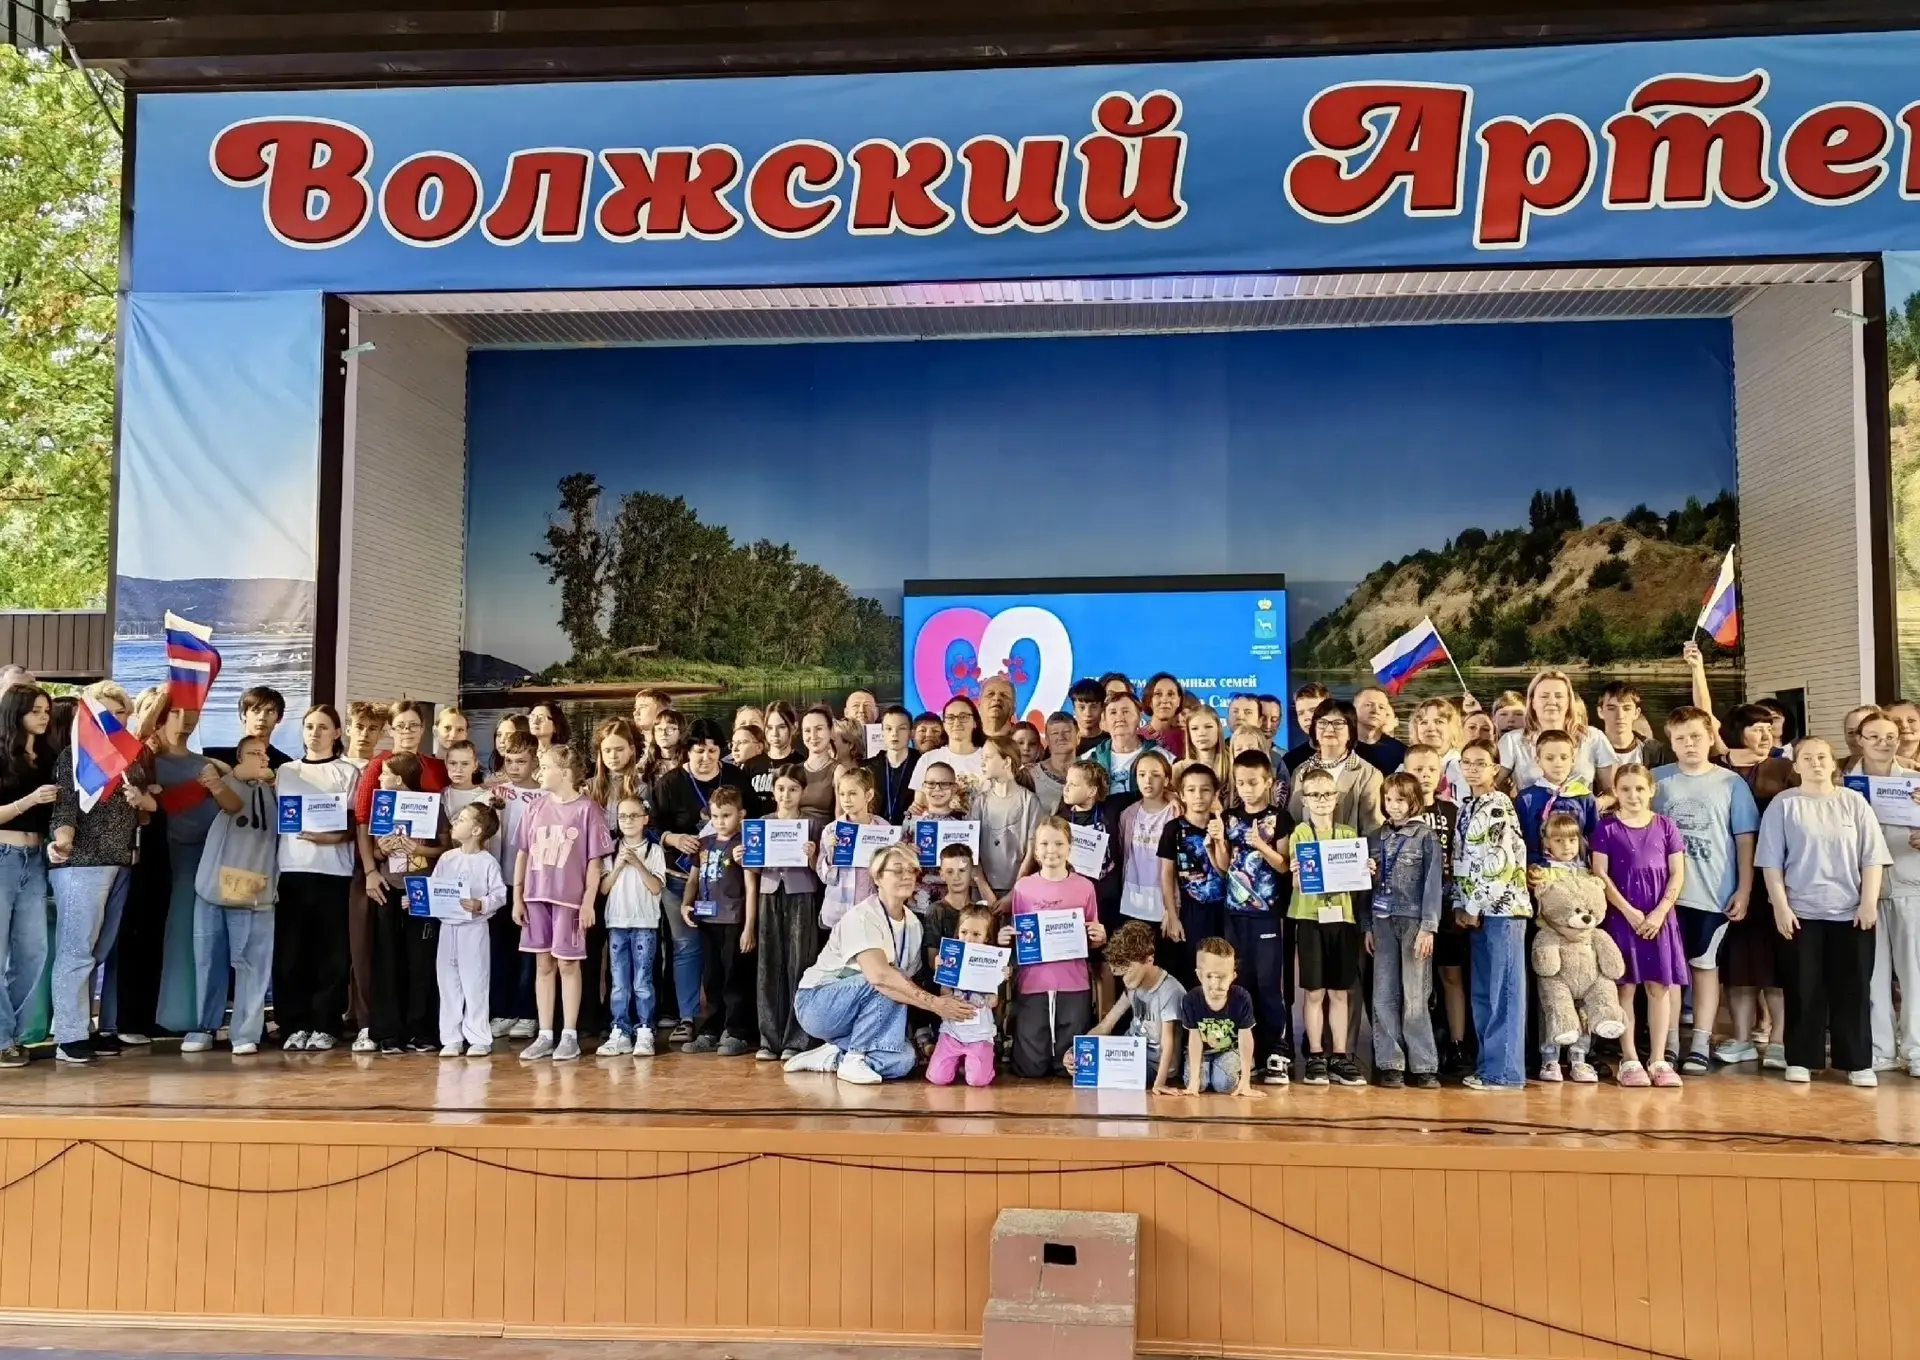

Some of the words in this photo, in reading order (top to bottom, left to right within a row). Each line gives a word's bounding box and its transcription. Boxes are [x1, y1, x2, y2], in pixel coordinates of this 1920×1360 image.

[209, 90, 1189, 250] Волжский
[1284, 68, 1920, 250] Арте
[1219, 674, 1257, 687] семей
[400, 803, 429, 811] ДИПЛОМ
[770, 831, 798, 839] ДИПЛОМ
[942, 832, 970, 840] ДИПЛОМ
[1328, 852, 1357, 861] ДИПЛОМ
[1045, 922, 1075, 931] ДИПЛОМ
[968, 957, 998, 965] ДИПЛОМ
[1105, 1049, 1135, 1057] ДИПЛОМ
